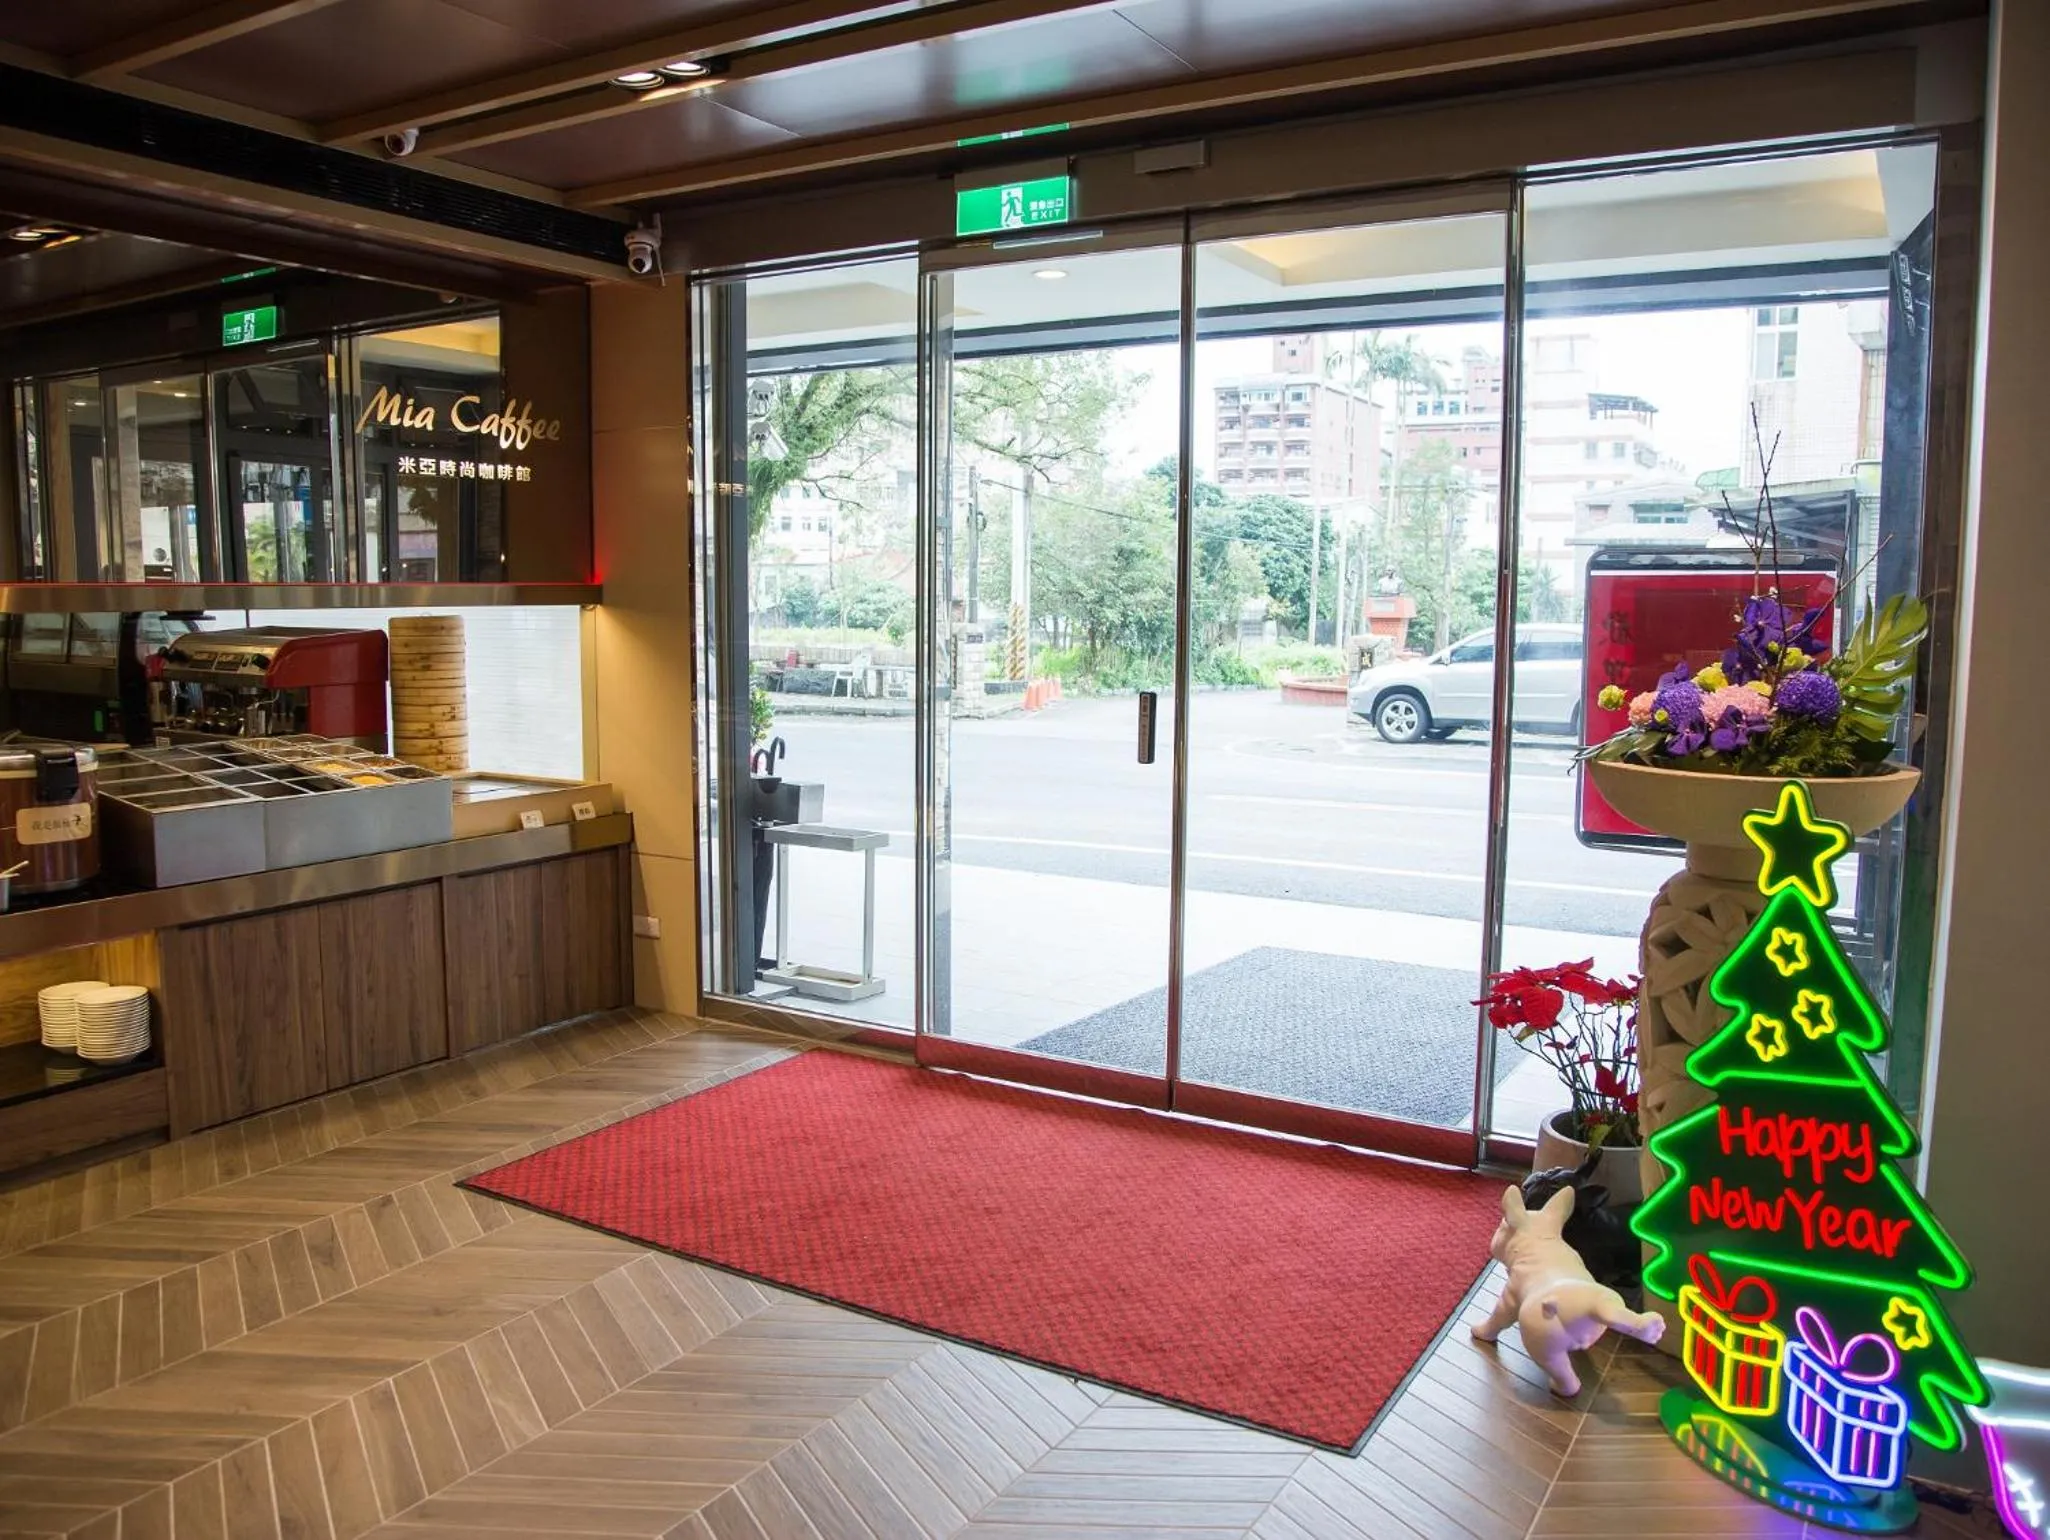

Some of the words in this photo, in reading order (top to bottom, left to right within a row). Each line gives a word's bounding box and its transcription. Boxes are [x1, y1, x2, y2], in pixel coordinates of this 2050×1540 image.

[1031, 208, 1061, 220] EXIT
[355, 386, 436, 434] Mia
[450, 395, 561, 450] Caffee
[398, 456, 531, 482] 米亞時尚咖啡館
[1718, 1105, 1874, 1184] Happy
